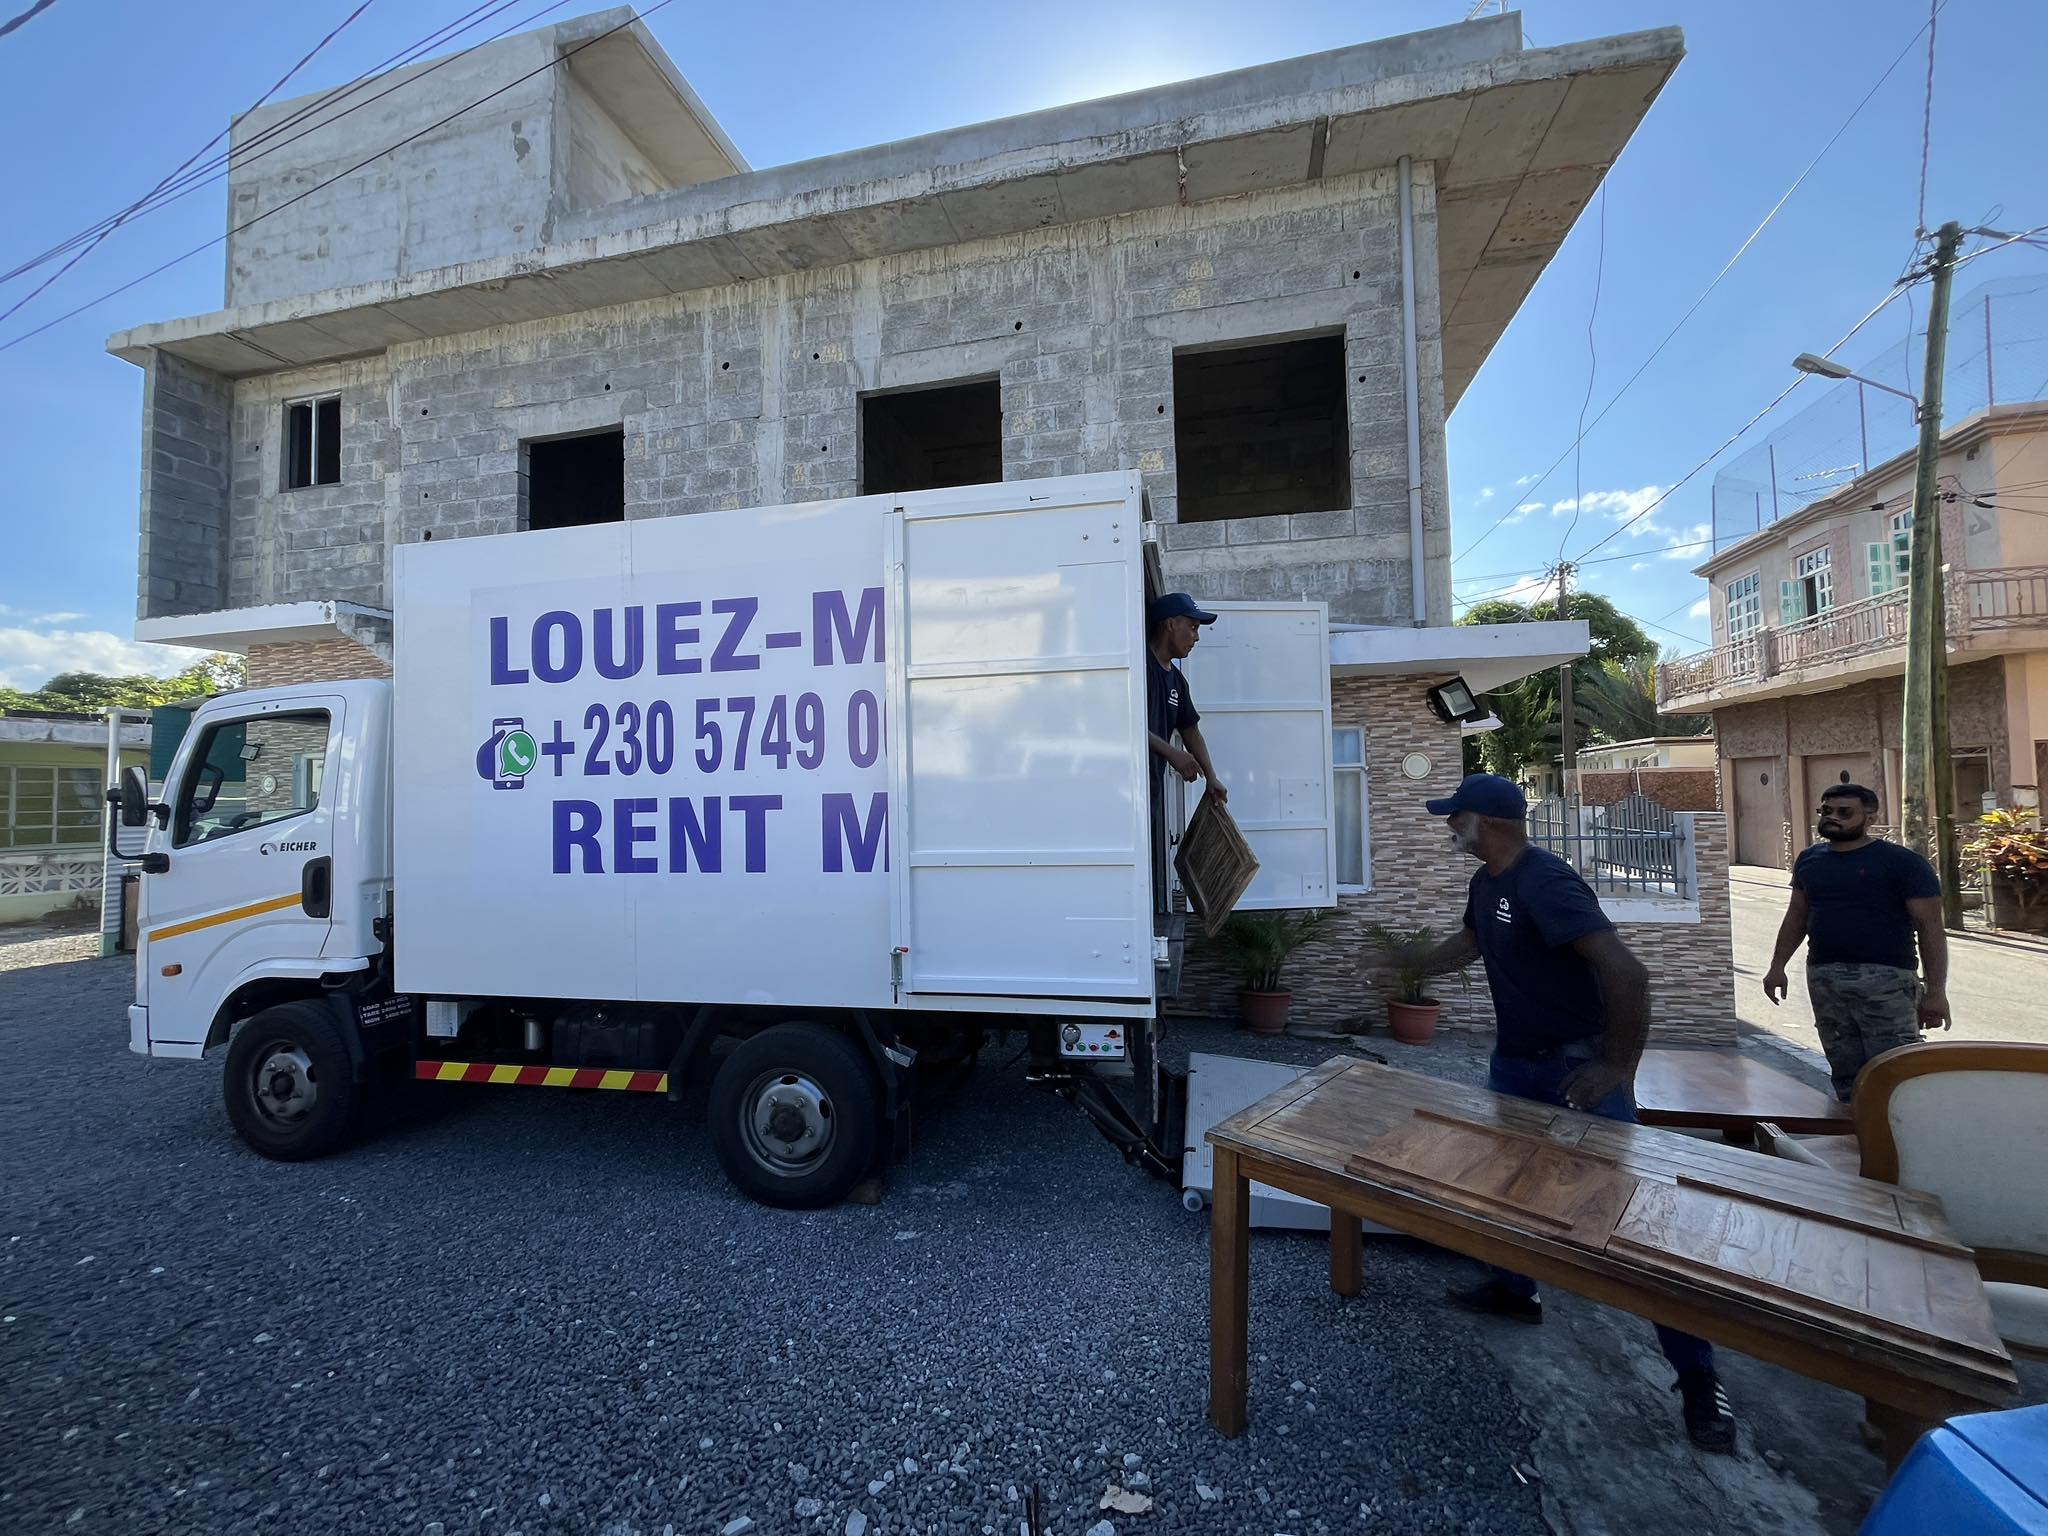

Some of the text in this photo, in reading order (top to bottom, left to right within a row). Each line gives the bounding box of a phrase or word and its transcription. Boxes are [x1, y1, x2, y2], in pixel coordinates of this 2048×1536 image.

[541, 688, 888, 777] +230 5749 0
[280, 841, 317, 852] EICHER
[552, 791, 891, 875] RENT M
[362, 1009, 380, 1018] TARE
